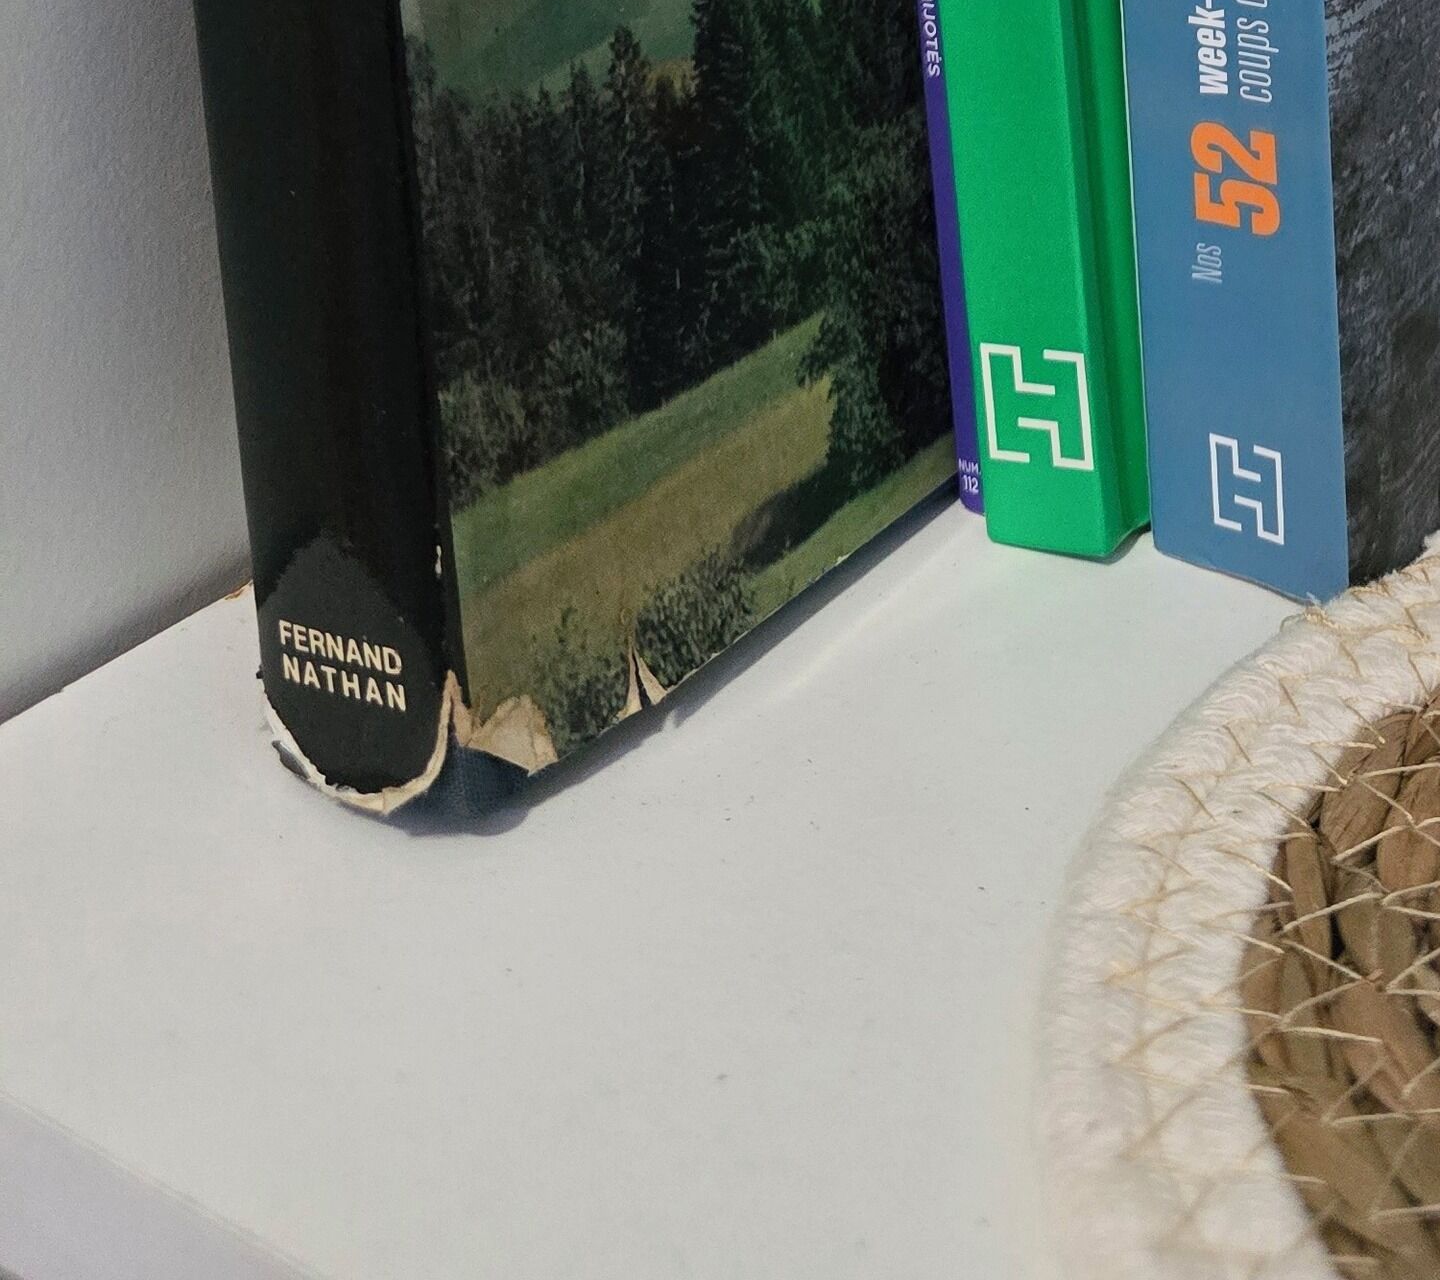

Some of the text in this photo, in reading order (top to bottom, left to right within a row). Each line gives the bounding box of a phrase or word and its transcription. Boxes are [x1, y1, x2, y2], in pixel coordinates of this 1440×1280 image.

[1236, 8, 1273, 106] coups
[1189, 118, 1282, 285] Nos 52
[963, 474, 979, 494] 112
[278, 619, 402, 676] FERNAND
[282, 653, 406, 712] NATHAN
